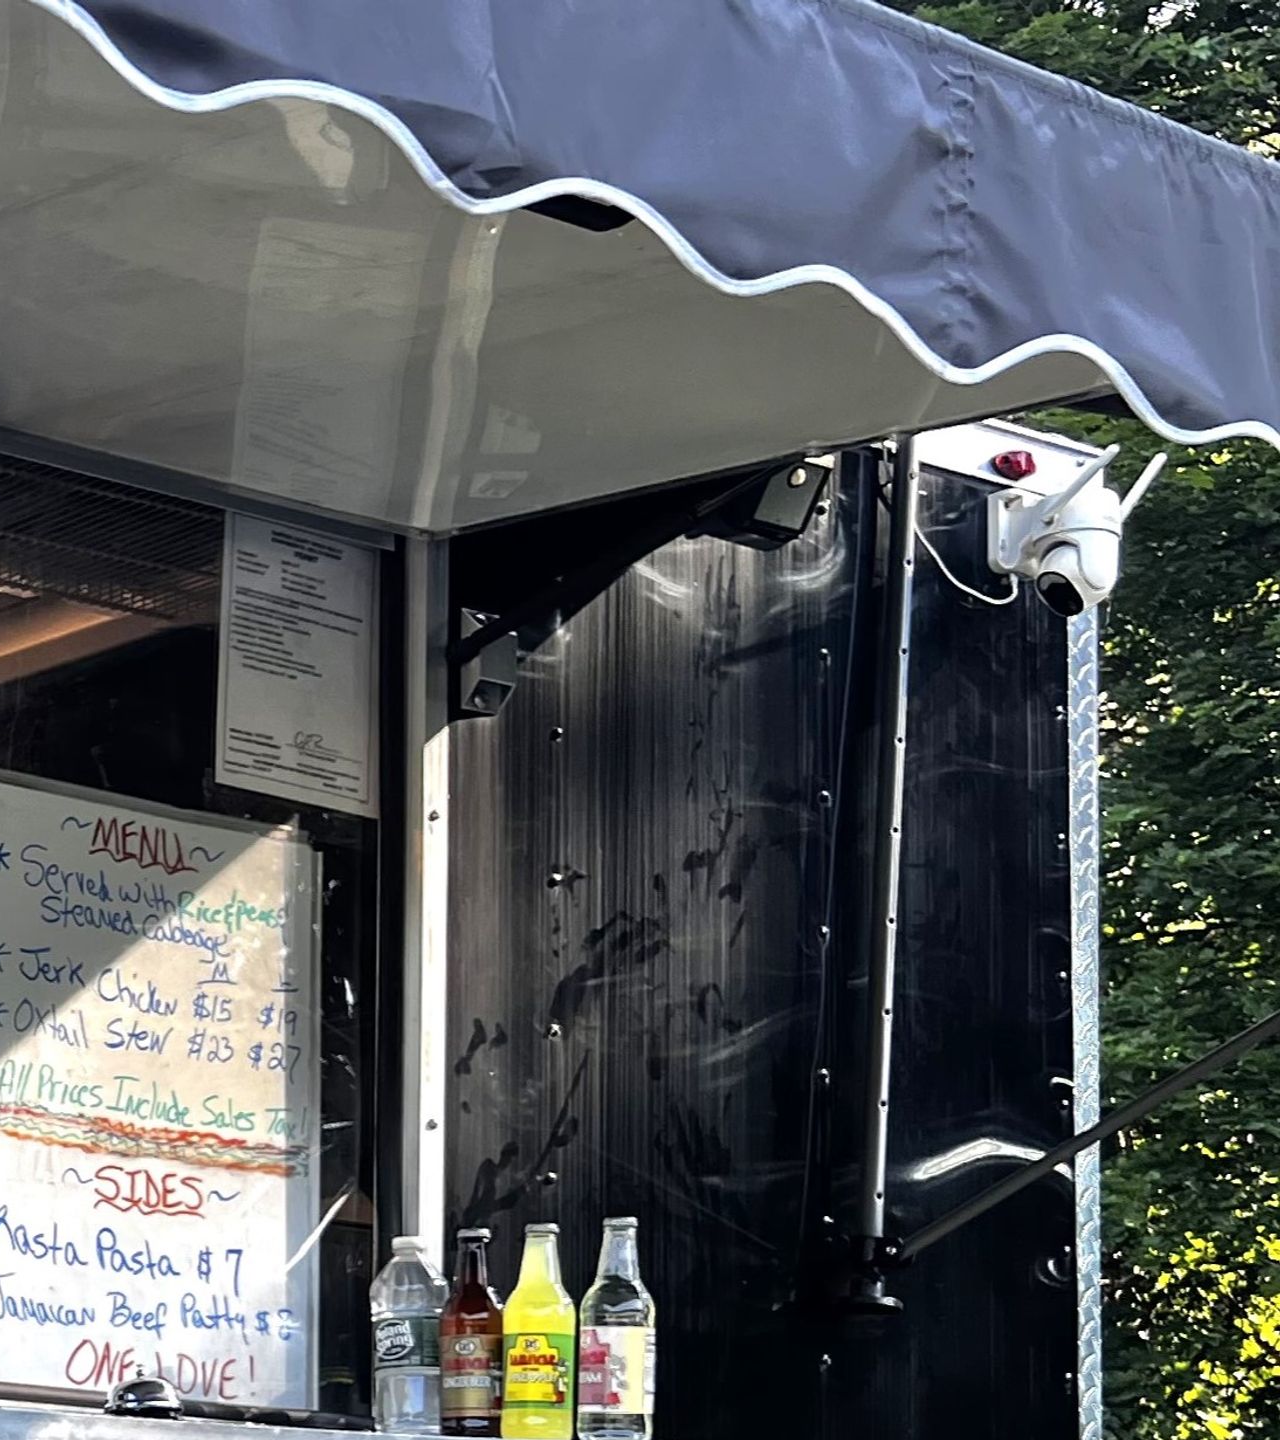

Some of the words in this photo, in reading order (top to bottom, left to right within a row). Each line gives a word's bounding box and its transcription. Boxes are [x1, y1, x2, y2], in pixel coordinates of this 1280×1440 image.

[20, 843, 110, 896] Served
[118, 879, 176, 914] with
[92, 817, 190, 871] MENU
[40, 894, 140, 936] Steamed
[142, 914, 231, 964] Cabbage
[18, 946, 87, 989] Jerk
[96, 967, 179, 1018] Chicken
[191, 992, 233, 1025] $15
[256, 1001, 299, 1038] $19
[12, 998, 90, 1050] Oxtail
[104, 1018, 175, 1056] Stew
[187, 1028, 235, 1065] $23
[247, 1041, 302, 1085] $27
[38, 1063, 105, 1111] Prices
[105, 1074, 194, 1127] Include
[200, 1094, 257, 1132] Sales
[93, 1165, 206, 1211] SIDES
[95, 1226, 182, 1281] Pasta
[106, 1291, 169, 1333] Beef
[180, 1292, 251, 1346] Patty
